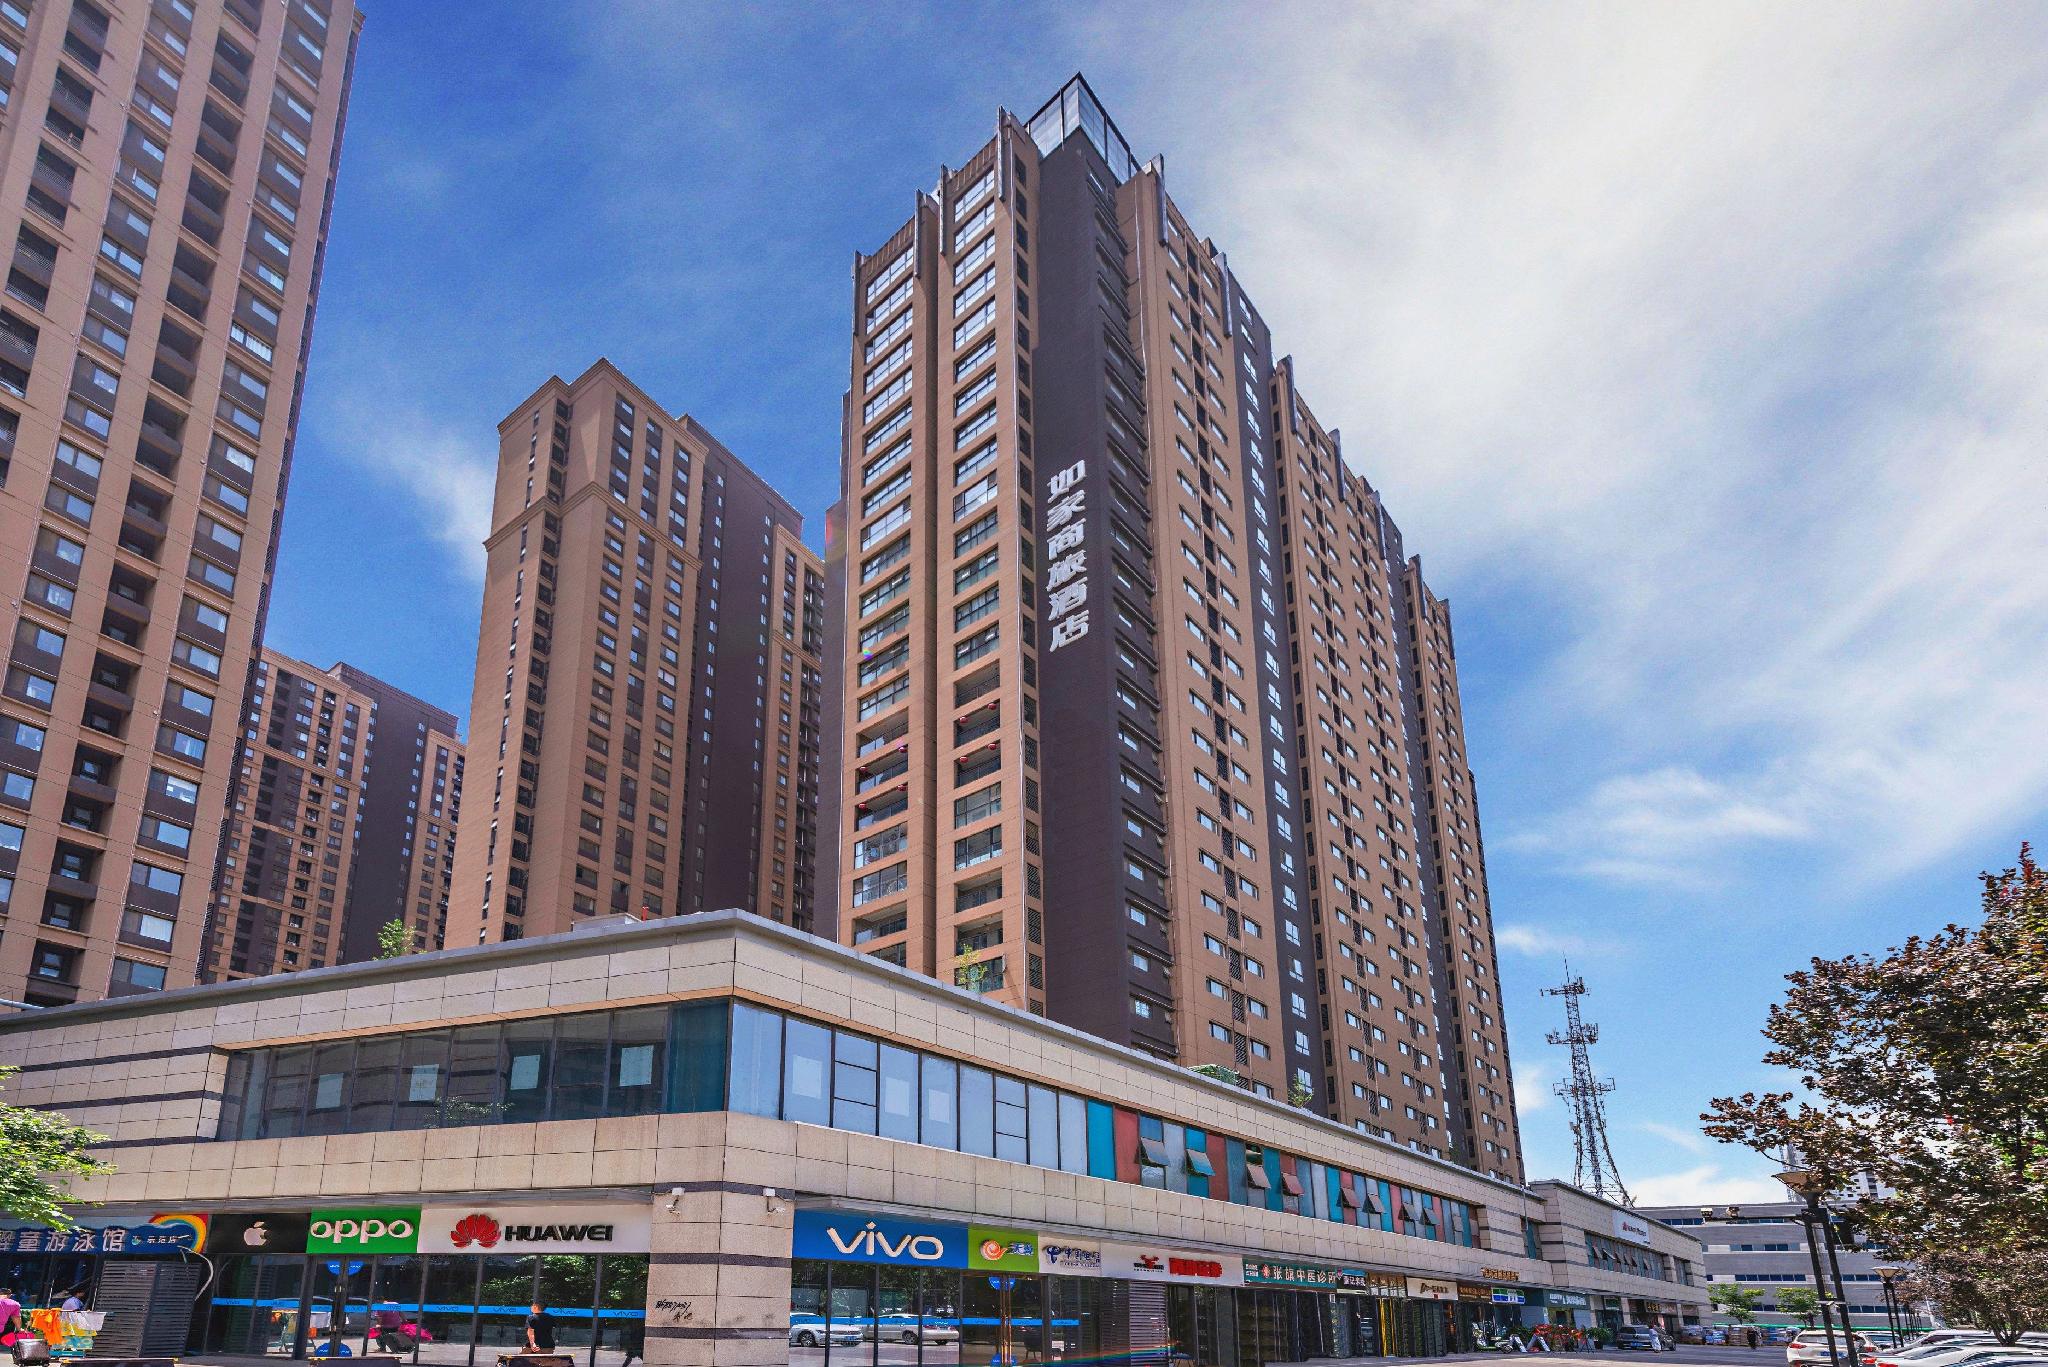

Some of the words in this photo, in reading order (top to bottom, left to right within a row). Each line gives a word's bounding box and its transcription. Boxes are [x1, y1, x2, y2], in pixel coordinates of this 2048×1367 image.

[1046, 459, 1089, 652] 如家商旅酒店
[505, 1225, 614, 1241] HUAWEI
[827, 1221, 944, 1260] vivo
